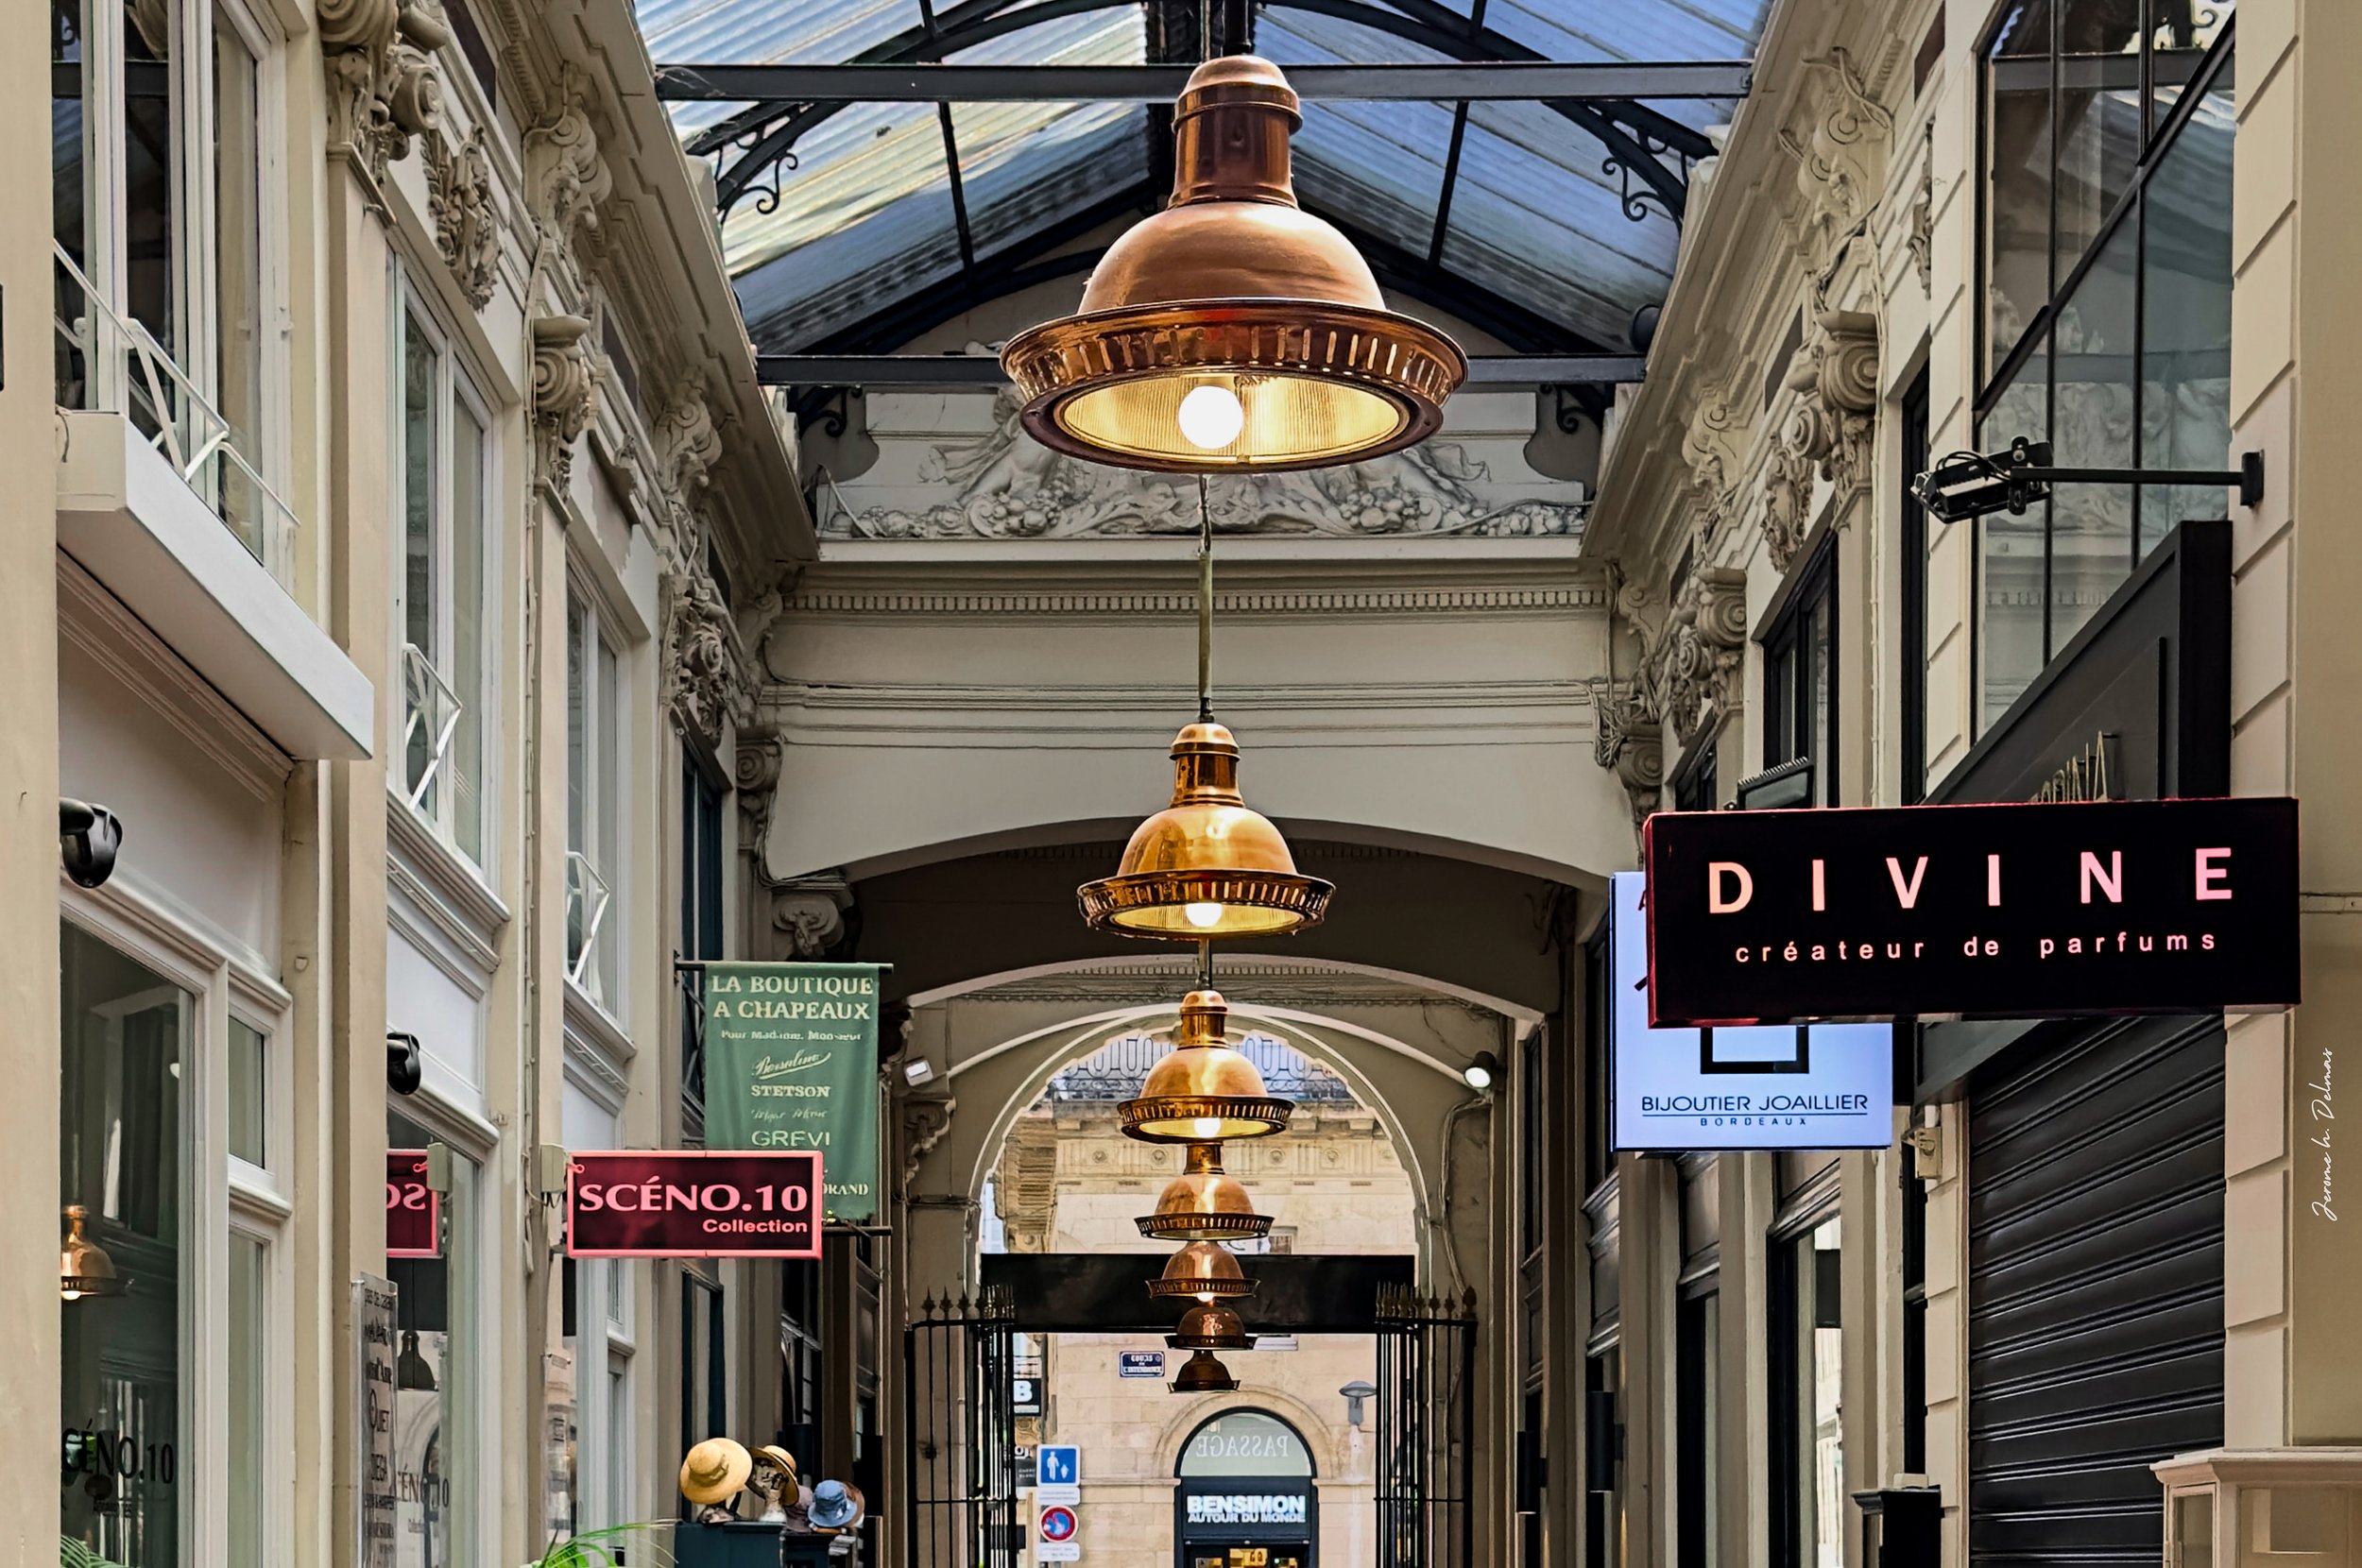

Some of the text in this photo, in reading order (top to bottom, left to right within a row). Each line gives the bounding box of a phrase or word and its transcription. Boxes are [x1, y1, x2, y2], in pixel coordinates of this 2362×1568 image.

[1707, 847, 2233, 914] DIVINE
[1736, 931, 2216, 963] créateur de parfums
[711, 976, 874, 997] LA BOUTIQUE
[738, 1001, 871, 1020] CHAPEAUX
[721, 1030, 746, 1039] Pour
[751, 1085, 831, 1098] STETSON
[1641, 1095, 1868, 1112] BIJOUTIER JOAILLIER
[1701, 1117, 1806, 1127] BORDEAUX
[579, 1176, 808, 1213] SCÉNO.10
[703, 1219, 808, 1233] Collection
[1187, 1495, 1306, 1513] BENSIMON
[1188, 1512, 1306, 1523] AUTOUR DU MONDE
